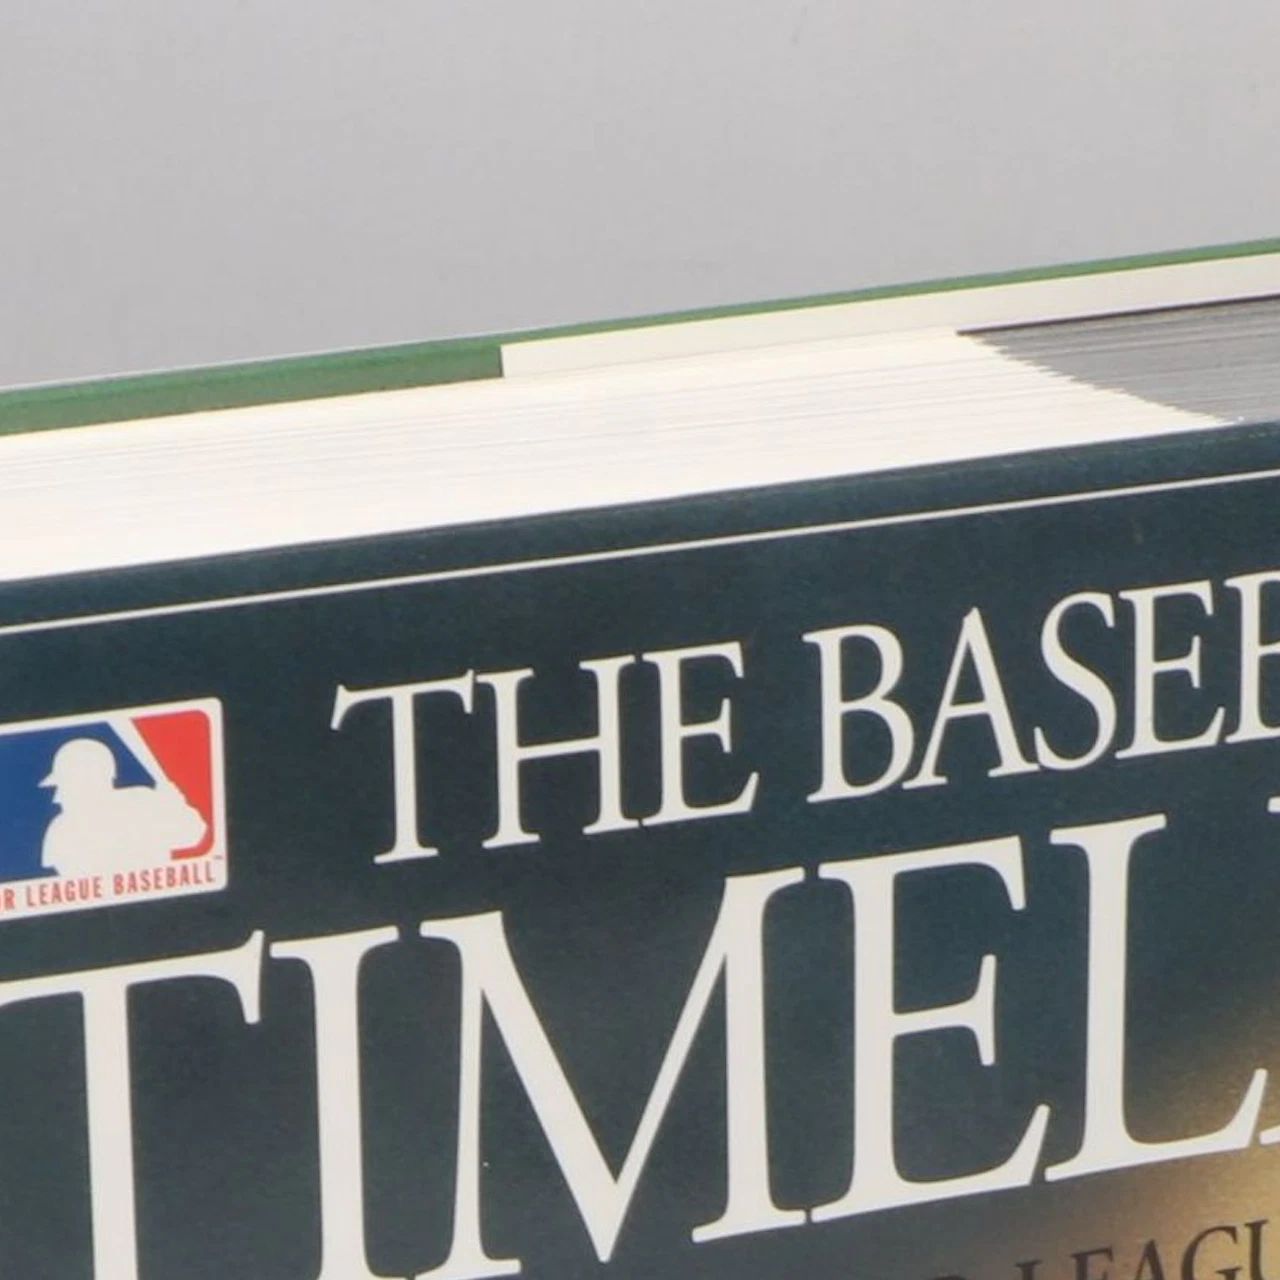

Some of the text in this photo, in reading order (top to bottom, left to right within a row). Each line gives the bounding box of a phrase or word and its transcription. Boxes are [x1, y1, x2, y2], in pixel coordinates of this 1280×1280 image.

[330, 641, 760, 864] THE
[25, 877, 103, 908] LEAGUE
[113, 861, 215, 896] BASEBALL
